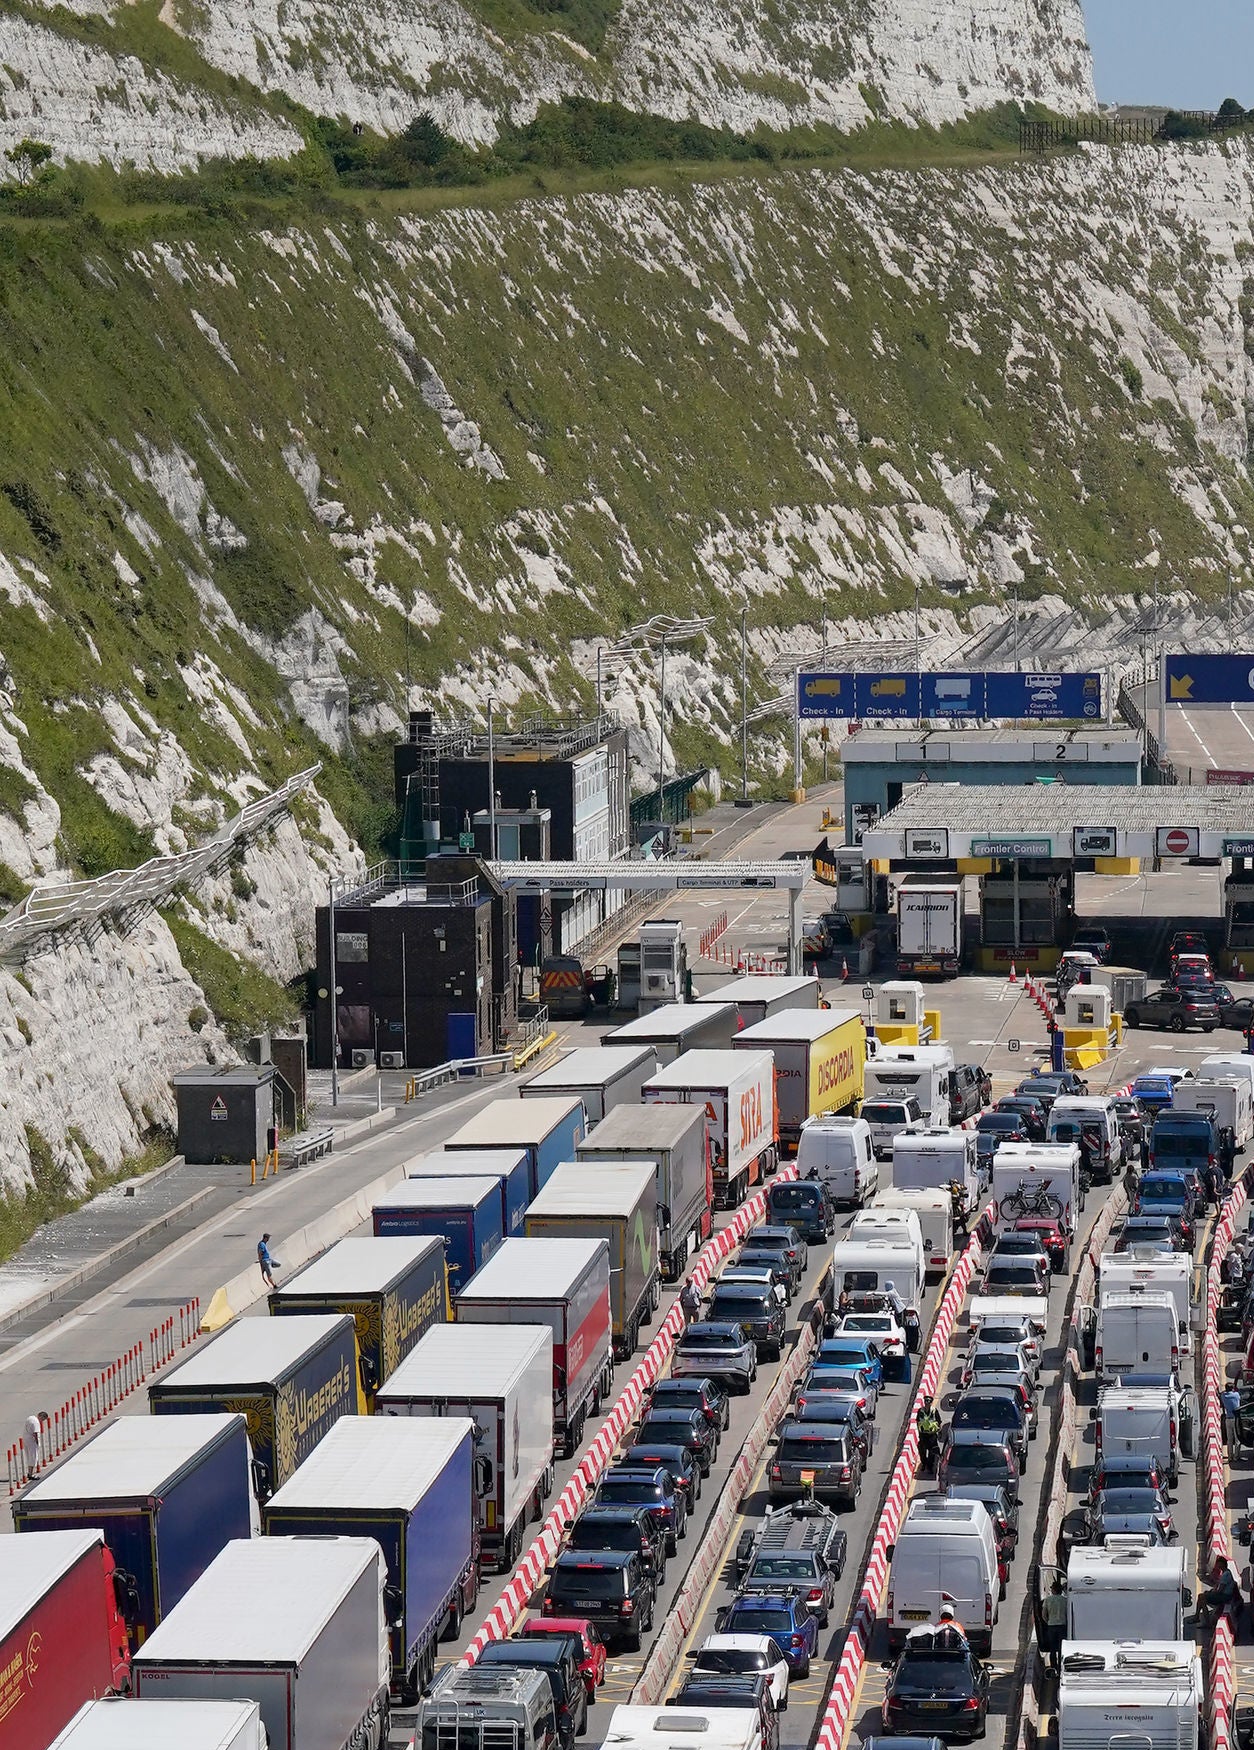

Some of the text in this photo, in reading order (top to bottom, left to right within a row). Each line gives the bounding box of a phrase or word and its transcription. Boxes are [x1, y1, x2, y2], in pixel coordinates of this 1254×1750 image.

[802, 707, 828, 715] Check
[866, 706, 892, 715] Check
[919, 744, 927, 759] 1
[1055, 744, 1066, 759] 2
[975, 844, 1048, 854] Frontier Control
[818, 1046, 854, 1096] DISCORDIA
